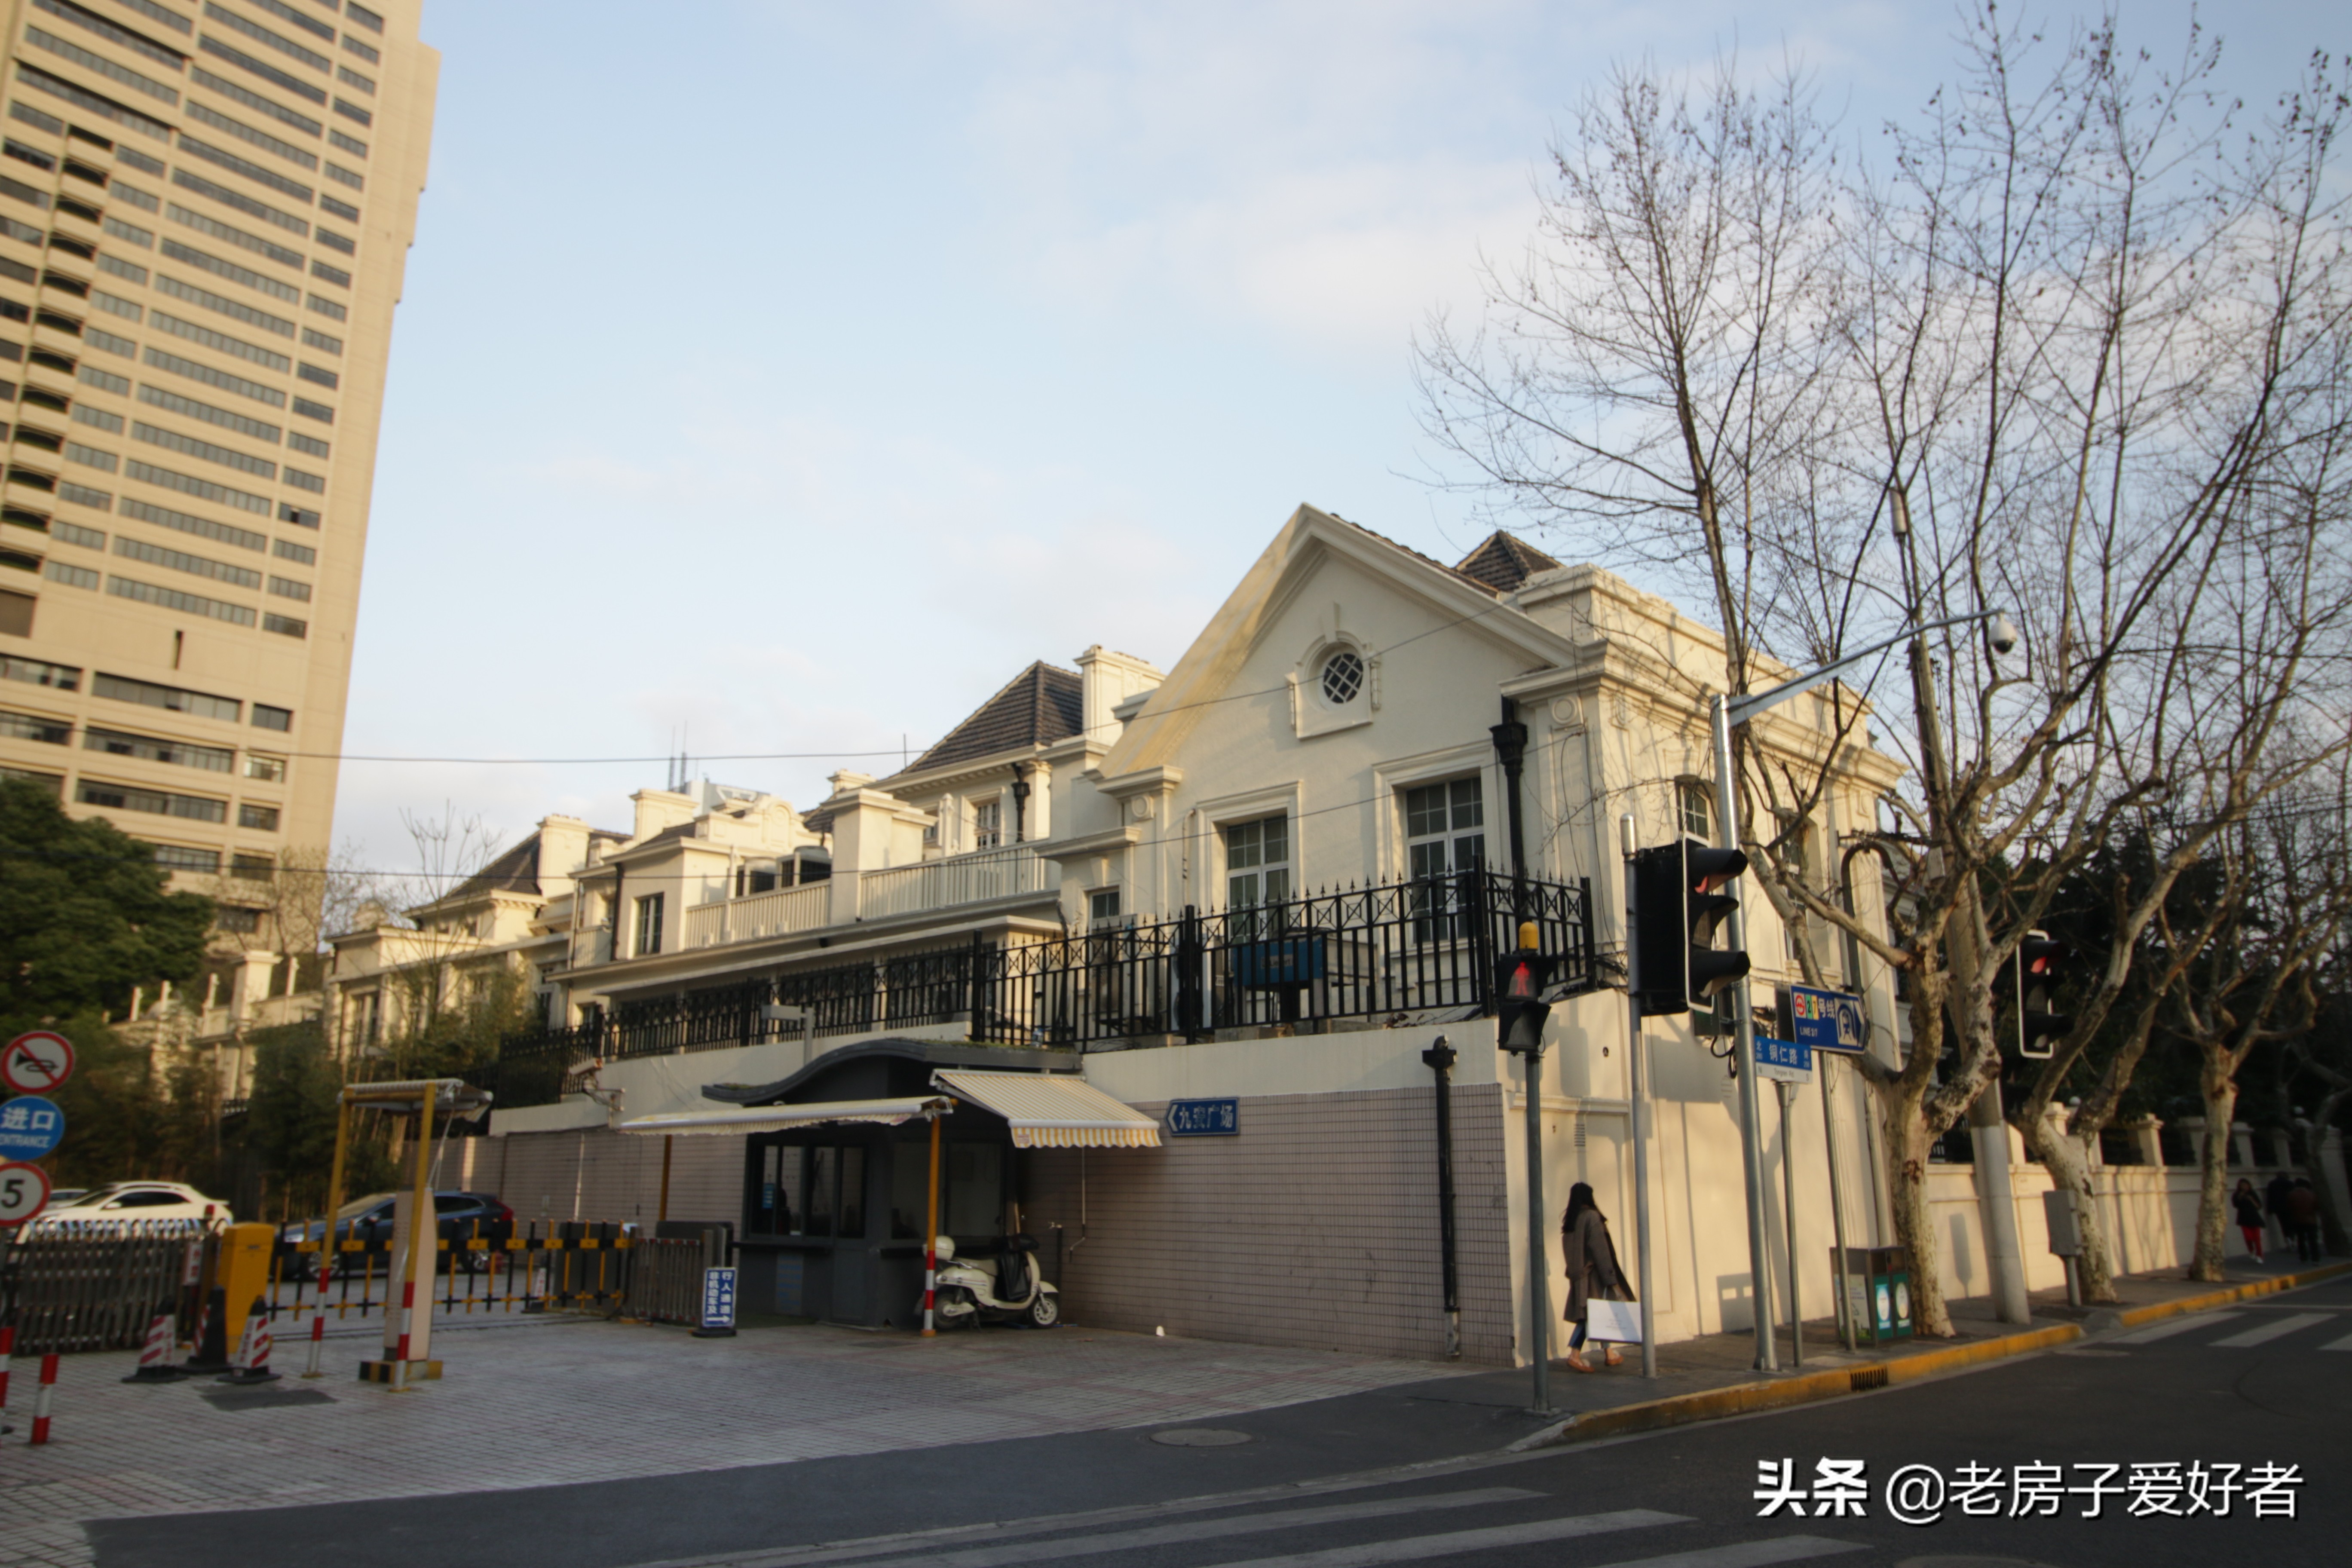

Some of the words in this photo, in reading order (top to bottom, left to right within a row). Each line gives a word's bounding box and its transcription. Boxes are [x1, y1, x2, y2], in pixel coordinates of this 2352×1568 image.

[1800, 1026, 1810, 1036] LINE
[1769, 1043, 1798, 1066] 铜仁路
[1758, 1066, 1762, 1074] N
[0, 1106, 55, 1131] 进口
[2, 1179, 25, 1209] 5
[706, 1271, 720, 1314] 非机动车及
[719, 1271, 733, 1314] 行人通道
